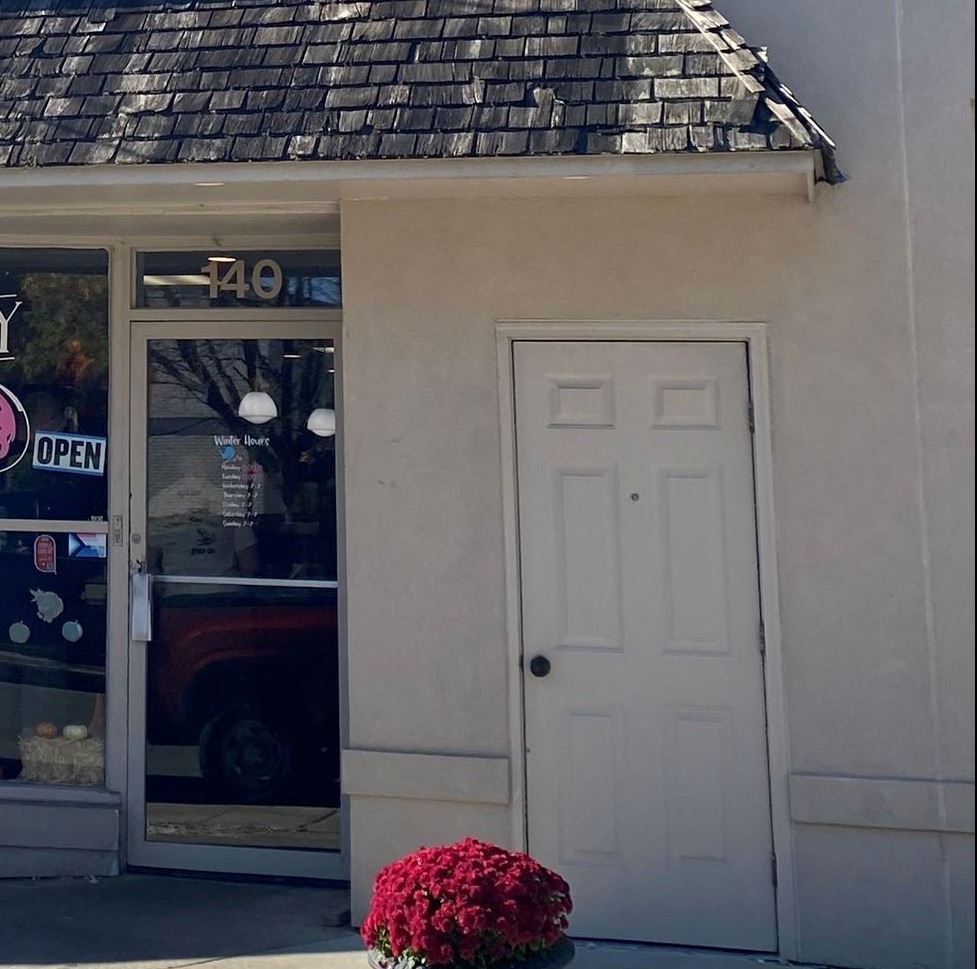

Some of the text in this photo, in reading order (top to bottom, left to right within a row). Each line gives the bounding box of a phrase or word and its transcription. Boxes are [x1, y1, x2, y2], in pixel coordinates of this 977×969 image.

[200, 258, 283, 300] 140
[36, 436, 102, 470] OPEN
[213, 434, 271, 447] Winter Hours
